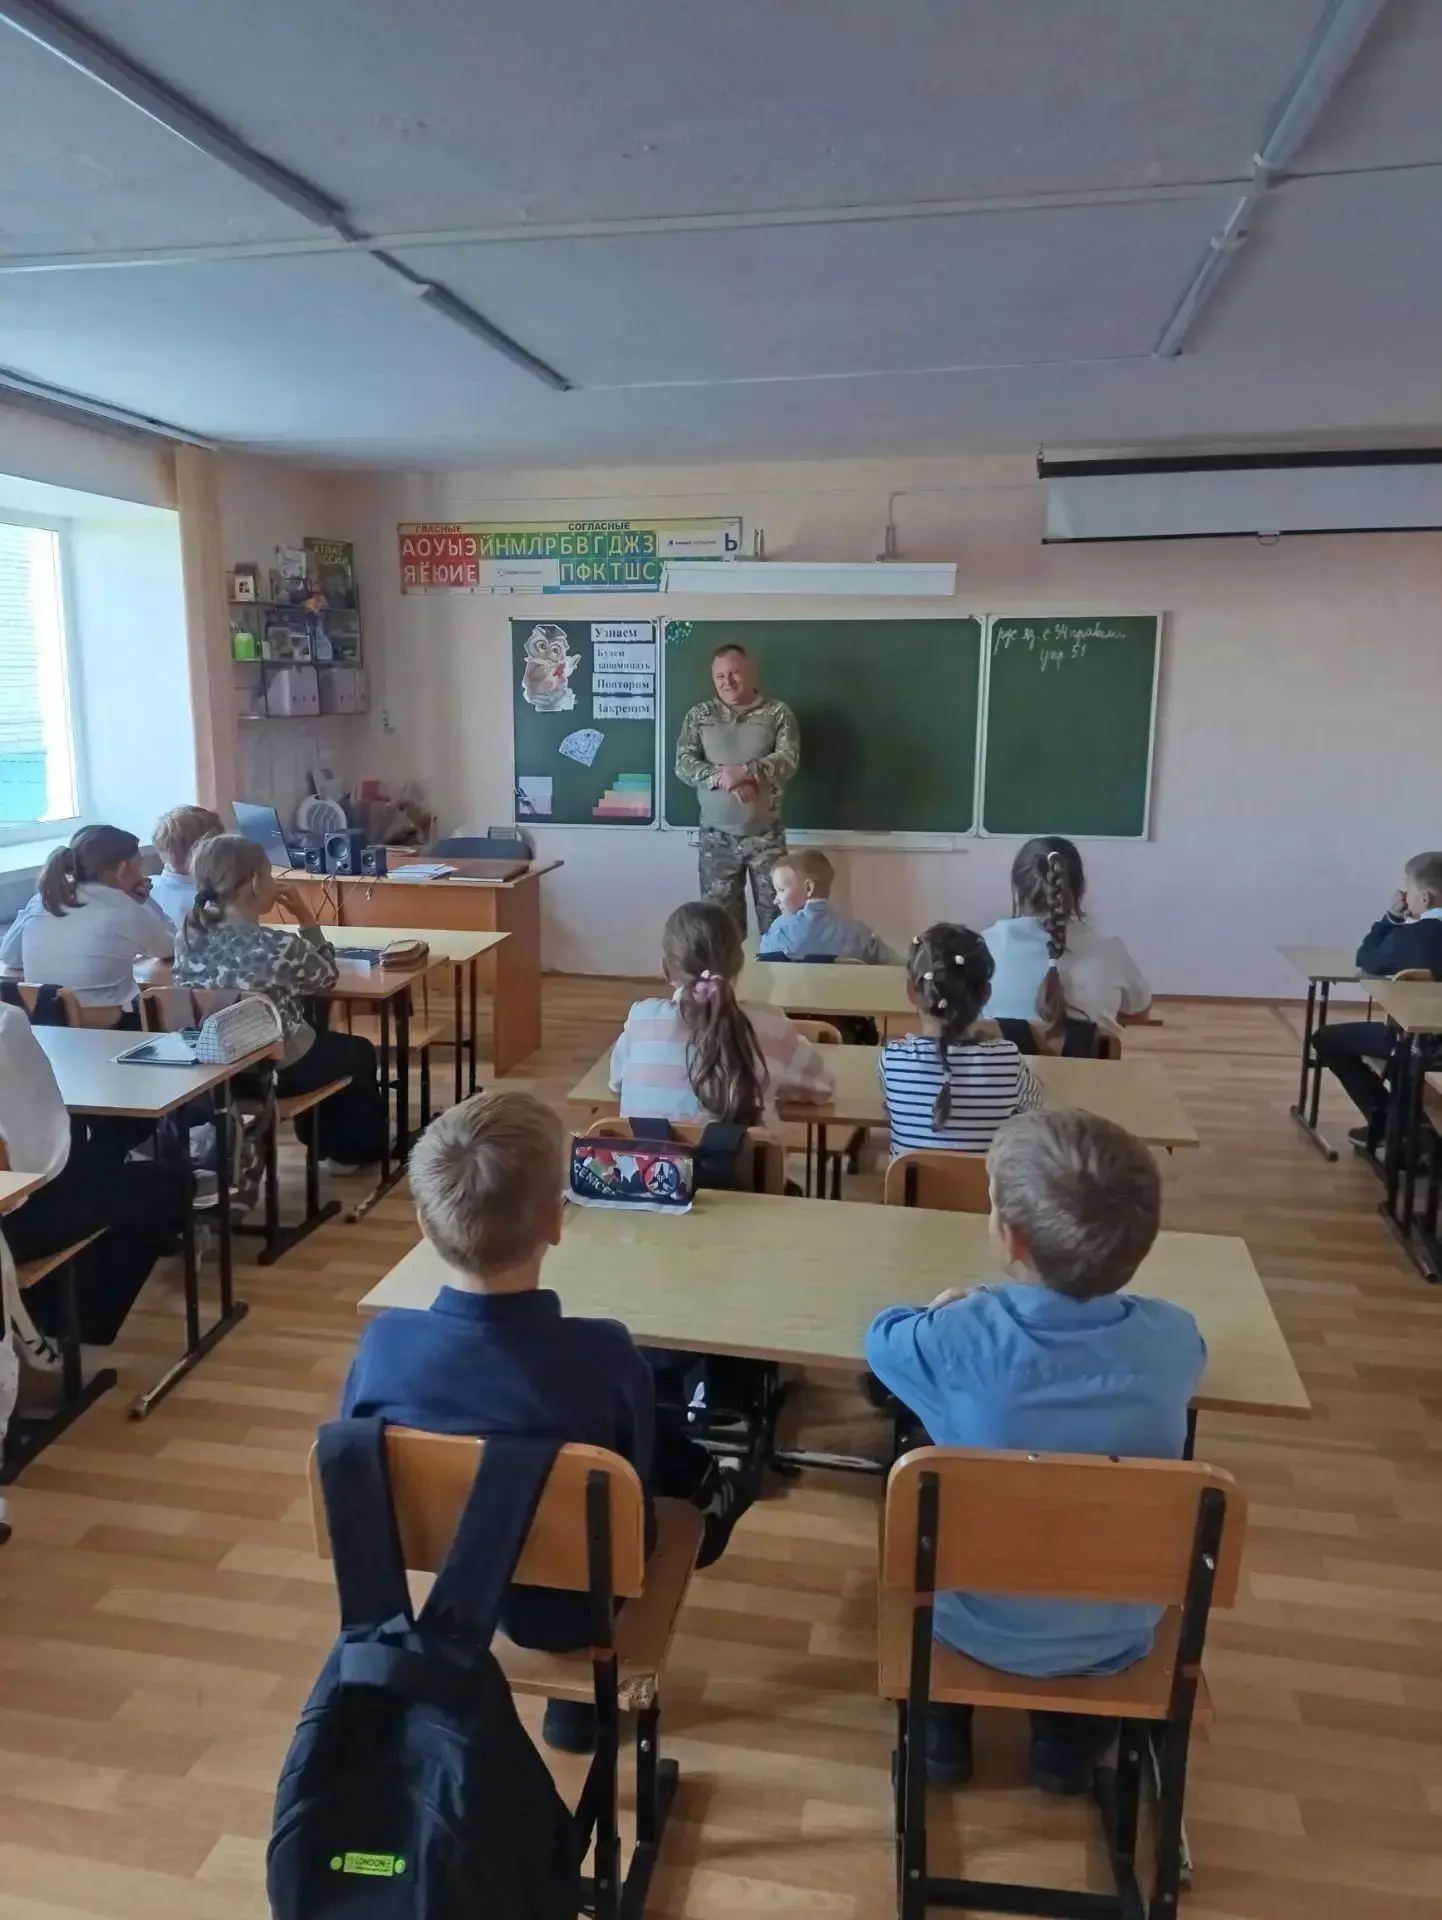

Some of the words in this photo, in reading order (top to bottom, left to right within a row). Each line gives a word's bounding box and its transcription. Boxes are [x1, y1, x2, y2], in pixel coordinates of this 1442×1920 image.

[415, 525, 463, 534] ГЛАСНЫЕ
[567, 520, 631, 531] СОГЛАСНЫЕ
[595, 627, 638, 639] Узнаем
[597, 648, 625, 659] Будем
[597, 678, 650, 691] Повторим
[598, 702, 650, 716] Закрепим
